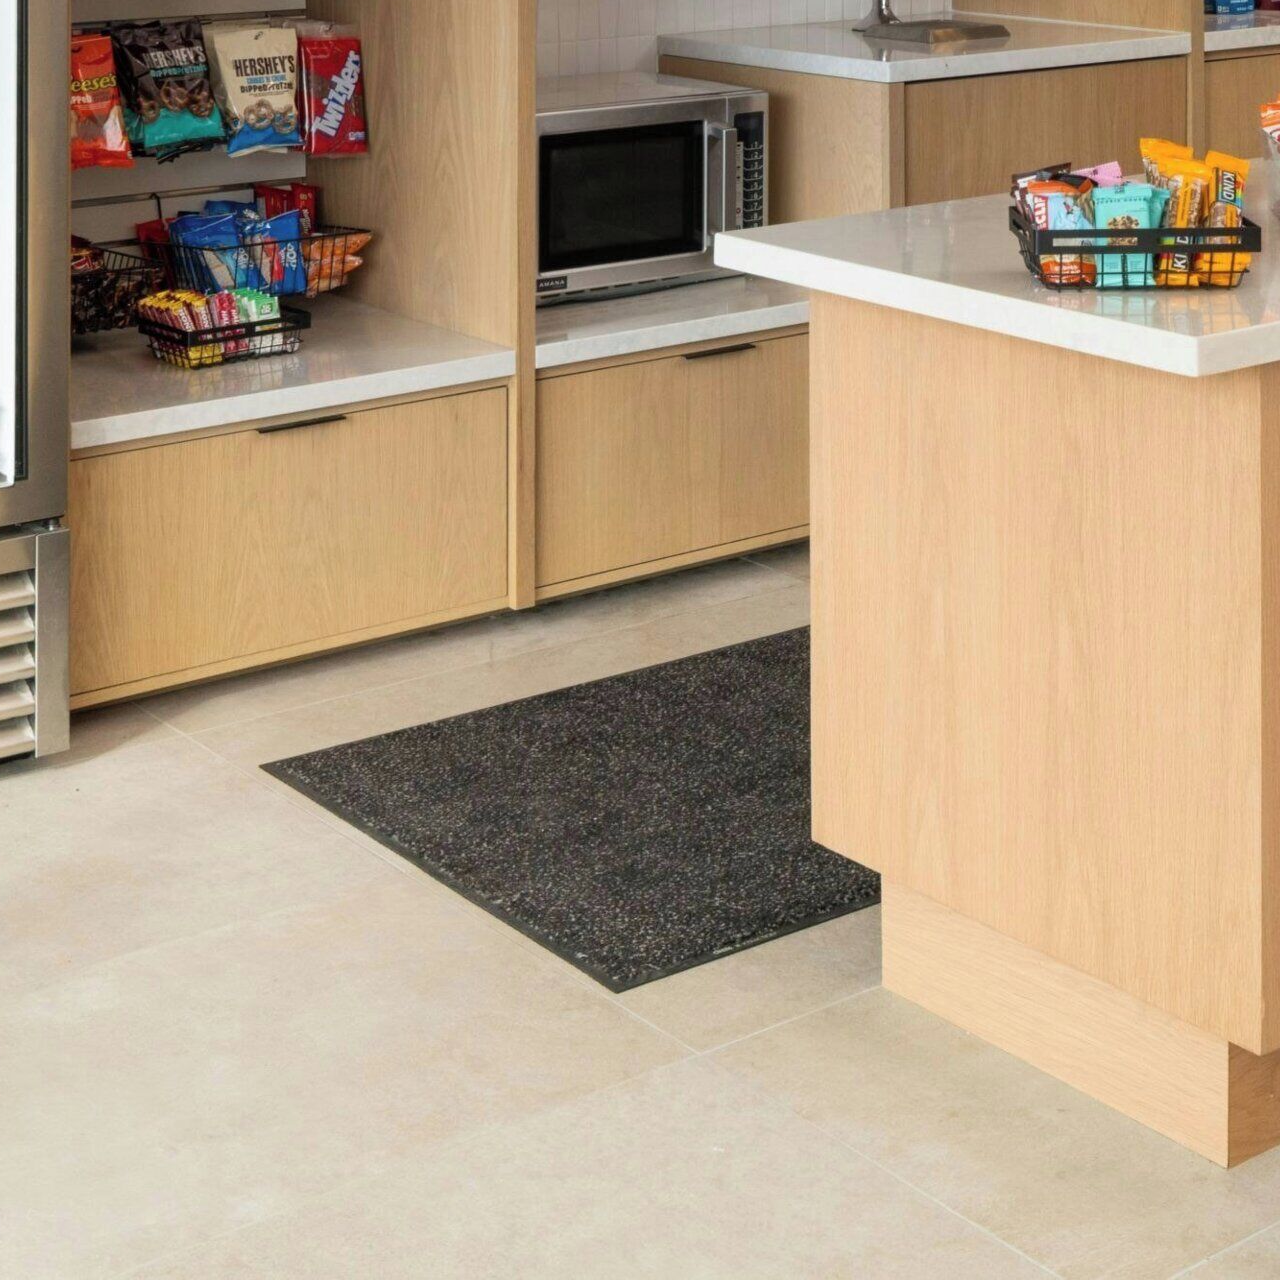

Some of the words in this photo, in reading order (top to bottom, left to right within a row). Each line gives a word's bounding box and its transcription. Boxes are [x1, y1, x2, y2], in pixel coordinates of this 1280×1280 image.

[142, 45, 207, 69] HERSHEY'S
[234, 55, 296, 78] HERSHEY'S
[70, 73, 117, 92] eese's
[1221, 170, 1236, 201] KIND
[539, 279, 565, 288] AMANA
